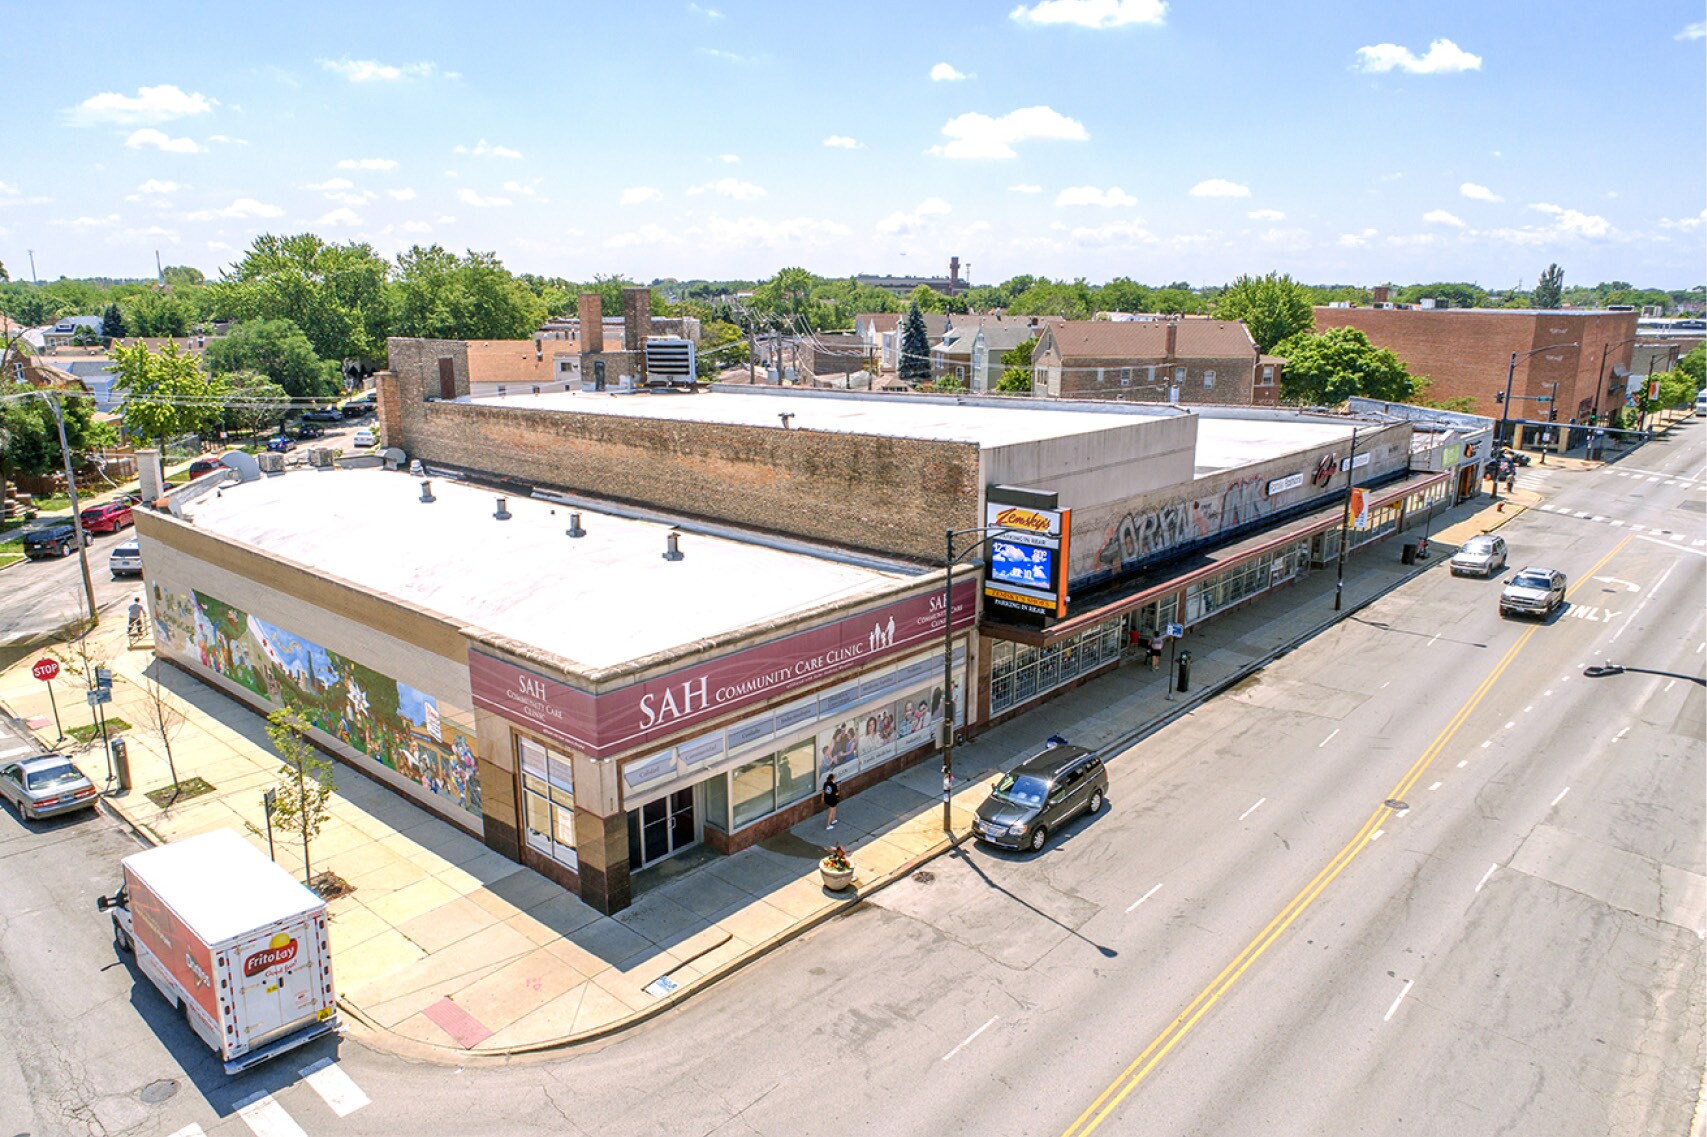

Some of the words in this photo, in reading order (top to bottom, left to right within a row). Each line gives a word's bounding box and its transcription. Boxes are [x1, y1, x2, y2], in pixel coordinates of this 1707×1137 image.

[33, 663, 58, 677] STOP
[519, 674, 546, 702] SAH
[639, 674, 710, 730] SAH
[715, 666, 793, 702] COMMUNITY
[795, 655, 823, 675] CARE
[826, 642, 864, 664] CLINIC
